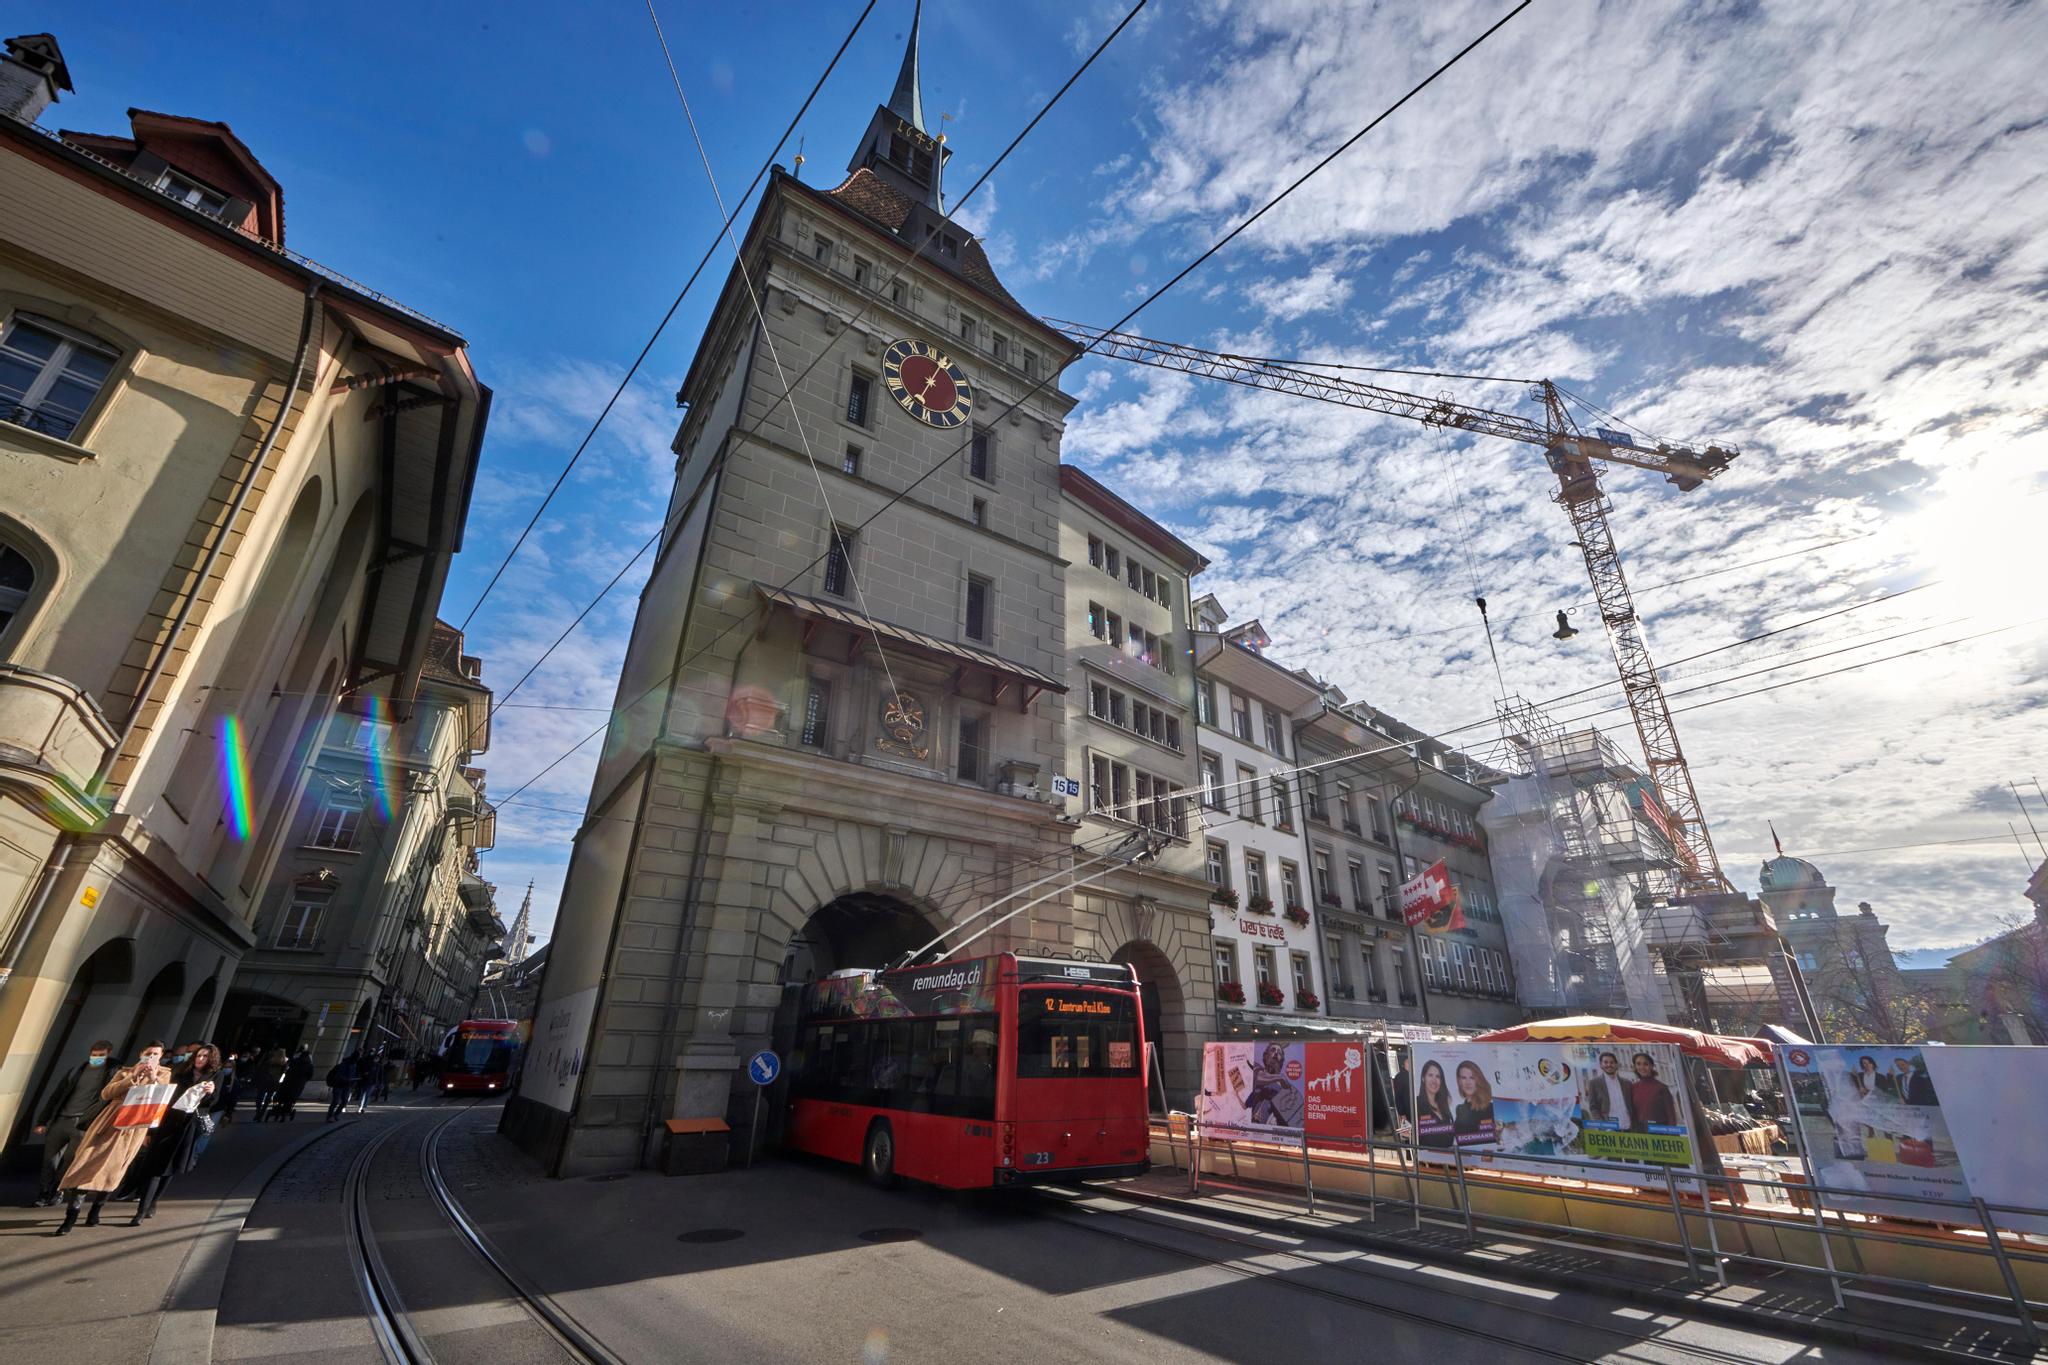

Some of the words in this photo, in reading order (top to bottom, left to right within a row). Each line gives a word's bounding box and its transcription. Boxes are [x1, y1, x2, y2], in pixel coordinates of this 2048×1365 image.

[896, 119, 935, 152] 1643
[891, 345, 906, 360] X
[941, 413, 951, 426] V
[1053, 779, 1066, 793] 15
[1068, 782, 1079, 794] 15
[912, 965, 981, 991] remundag.ch
[1063, 966, 1091, 978] HESS
[1045, 997, 1055, 1011] 12
[1058, 999, 1083, 1013] Zentrum
[1083, 1001, 1097, 1013] Paul
[1097, 1001, 1111, 1014] Klee
[1307, 1095, 1321, 1103] DAS
[1307, 1104, 1357, 1114] SOLIDARISCHE
[1307, 1112, 1327, 1120] BERN
[1589, 1134, 1616, 1147] BERN
[1619, 1137, 1649, 1151] KANN
[1652, 1139, 1685, 1153] MEHR
[1036, 1151, 1049, 1165] 23
